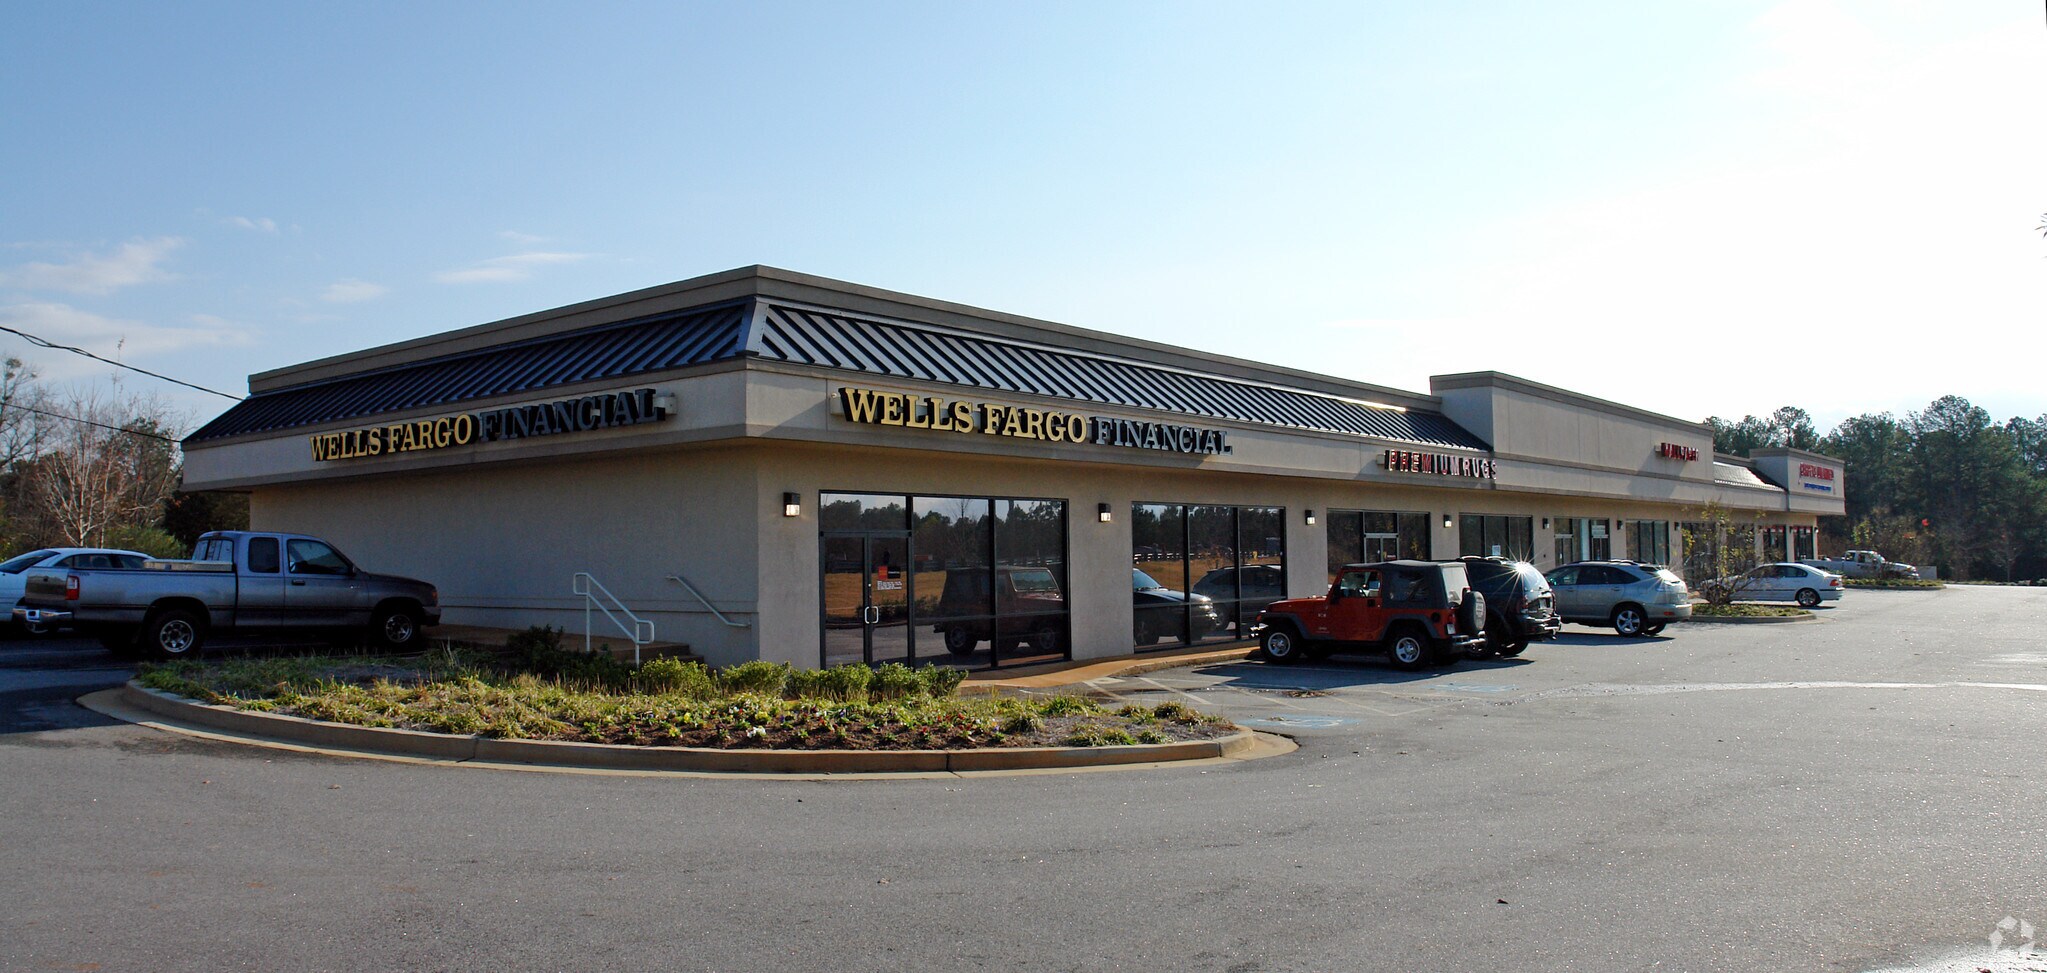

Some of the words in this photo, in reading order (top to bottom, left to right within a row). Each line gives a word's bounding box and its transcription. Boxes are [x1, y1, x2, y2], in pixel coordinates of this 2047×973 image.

[309, 427, 382, 462] WELLS
[387, 413, 473, 454] FARGO
[479, 388, 660, 443] FINANCIAL
[844, 387, 974, 433] WELLS
[983, 403, 1088, 444] FARGO
[1095, 416, 1233, 456] FINANCIAL
[1388, 449, 1460, 476] PREMIUM
[1462, 457, 1498, 480] RUGS
